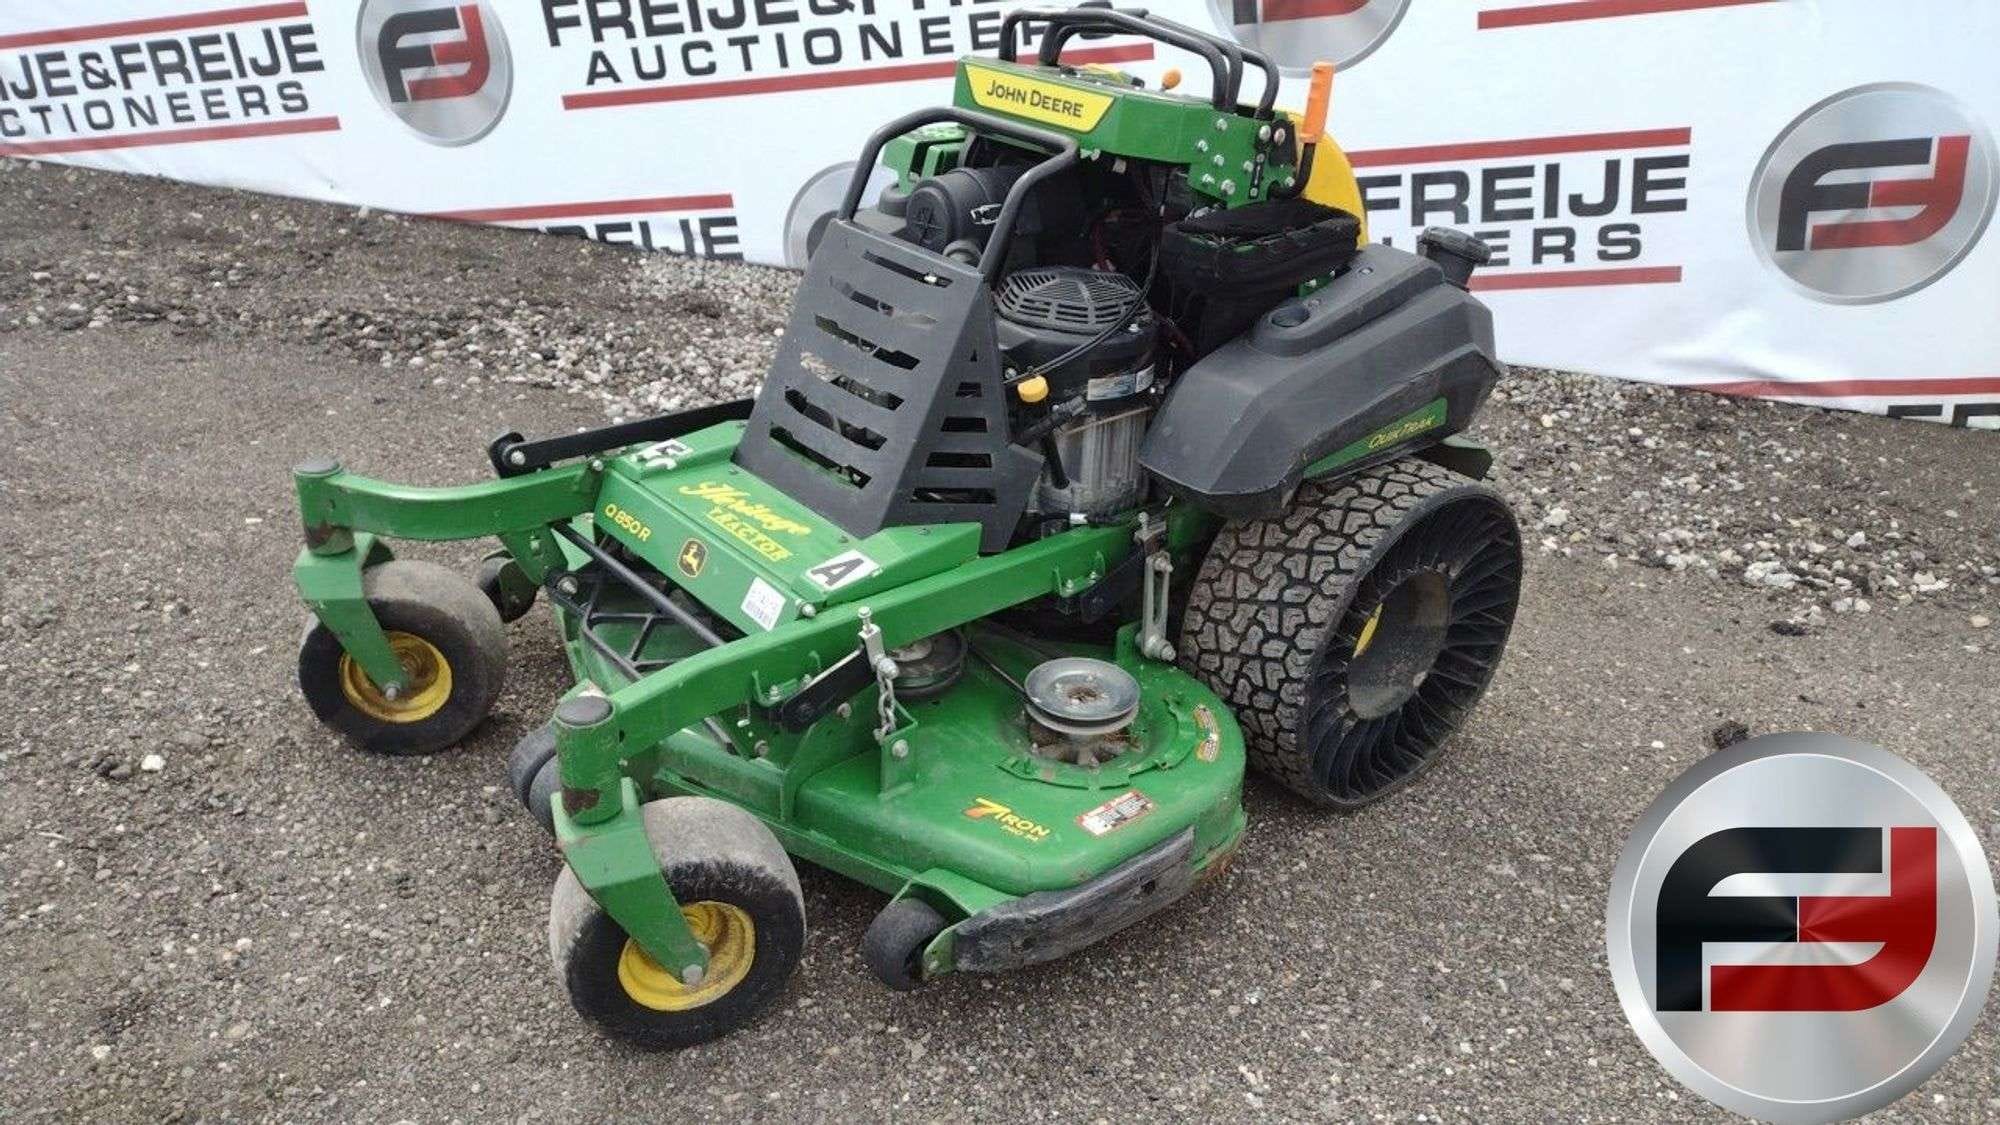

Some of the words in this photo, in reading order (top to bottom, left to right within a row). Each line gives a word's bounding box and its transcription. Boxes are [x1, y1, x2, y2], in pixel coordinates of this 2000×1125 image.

[987, 80, 1027, 105] JOHN
[1030, 90, 1084, 118] DEERE
[810, 557, 864, 587] A
